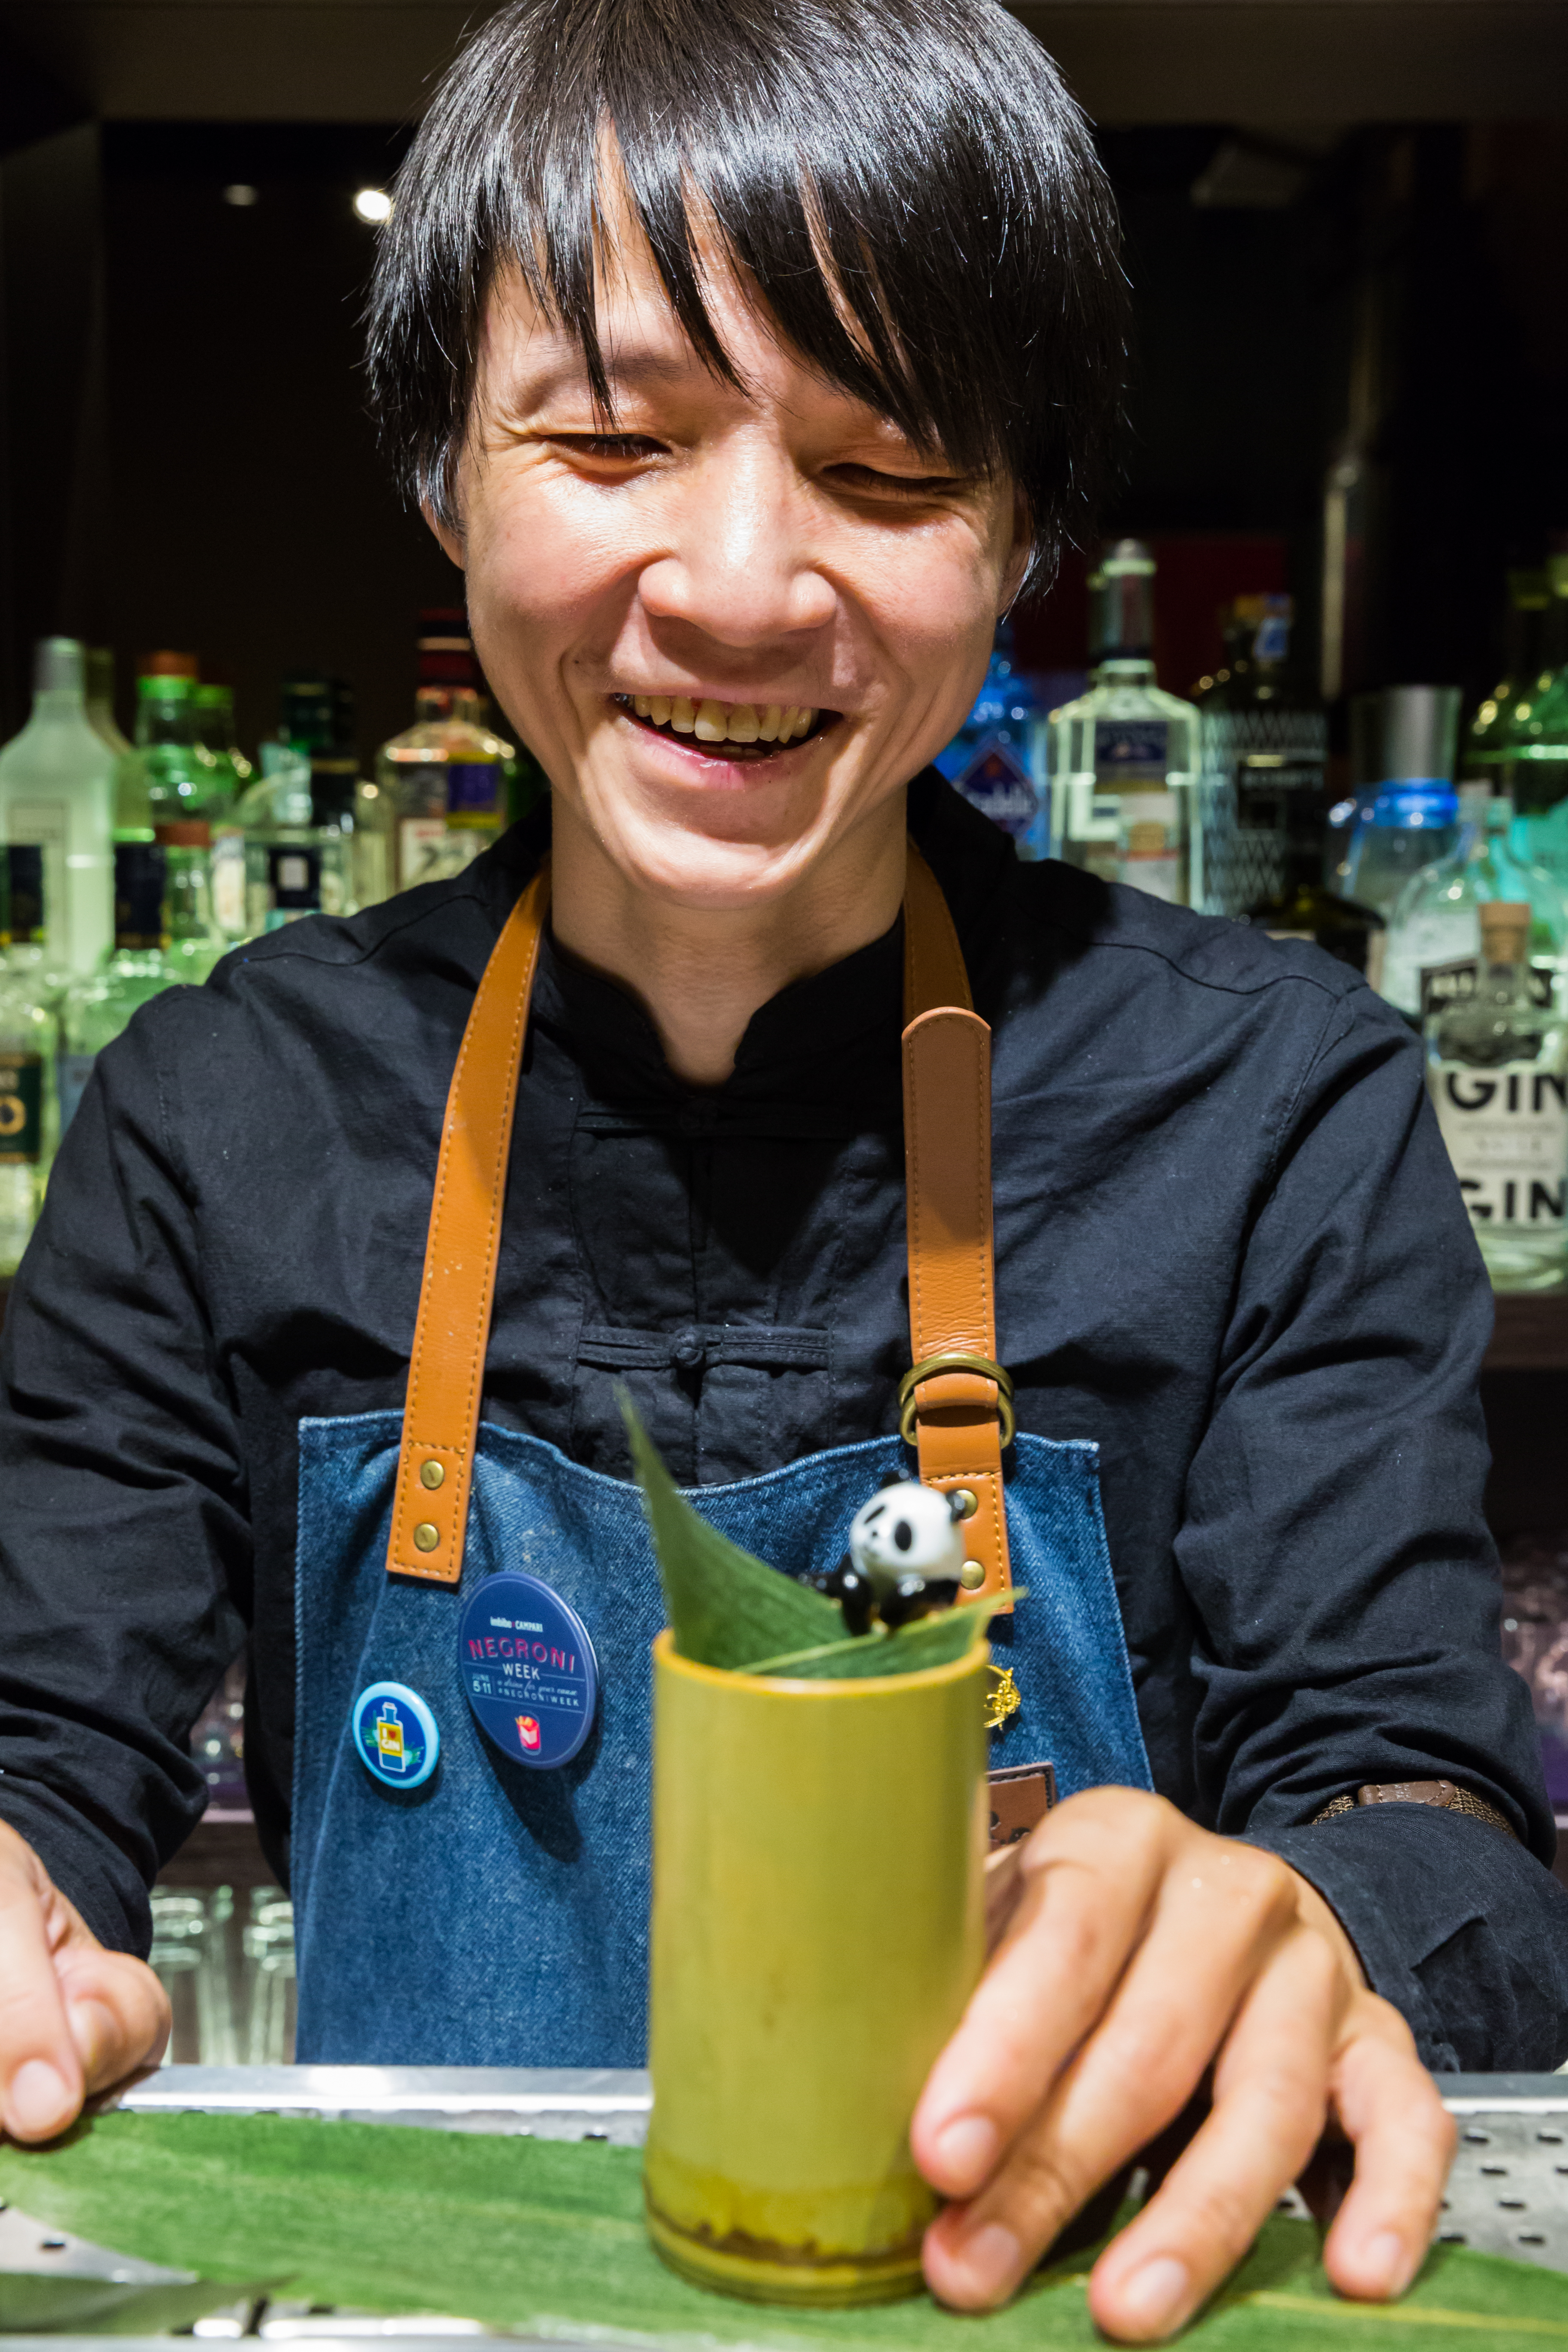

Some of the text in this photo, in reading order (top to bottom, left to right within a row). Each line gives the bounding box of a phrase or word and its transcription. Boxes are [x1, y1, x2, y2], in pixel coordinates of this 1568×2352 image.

[469, 1637, 575, 1673] NEGRONI
[502, 1663, 541, 1680] WEEK
[382, 1727, 387, 1738] I
[381, 1739, 401, 1752] GIN
